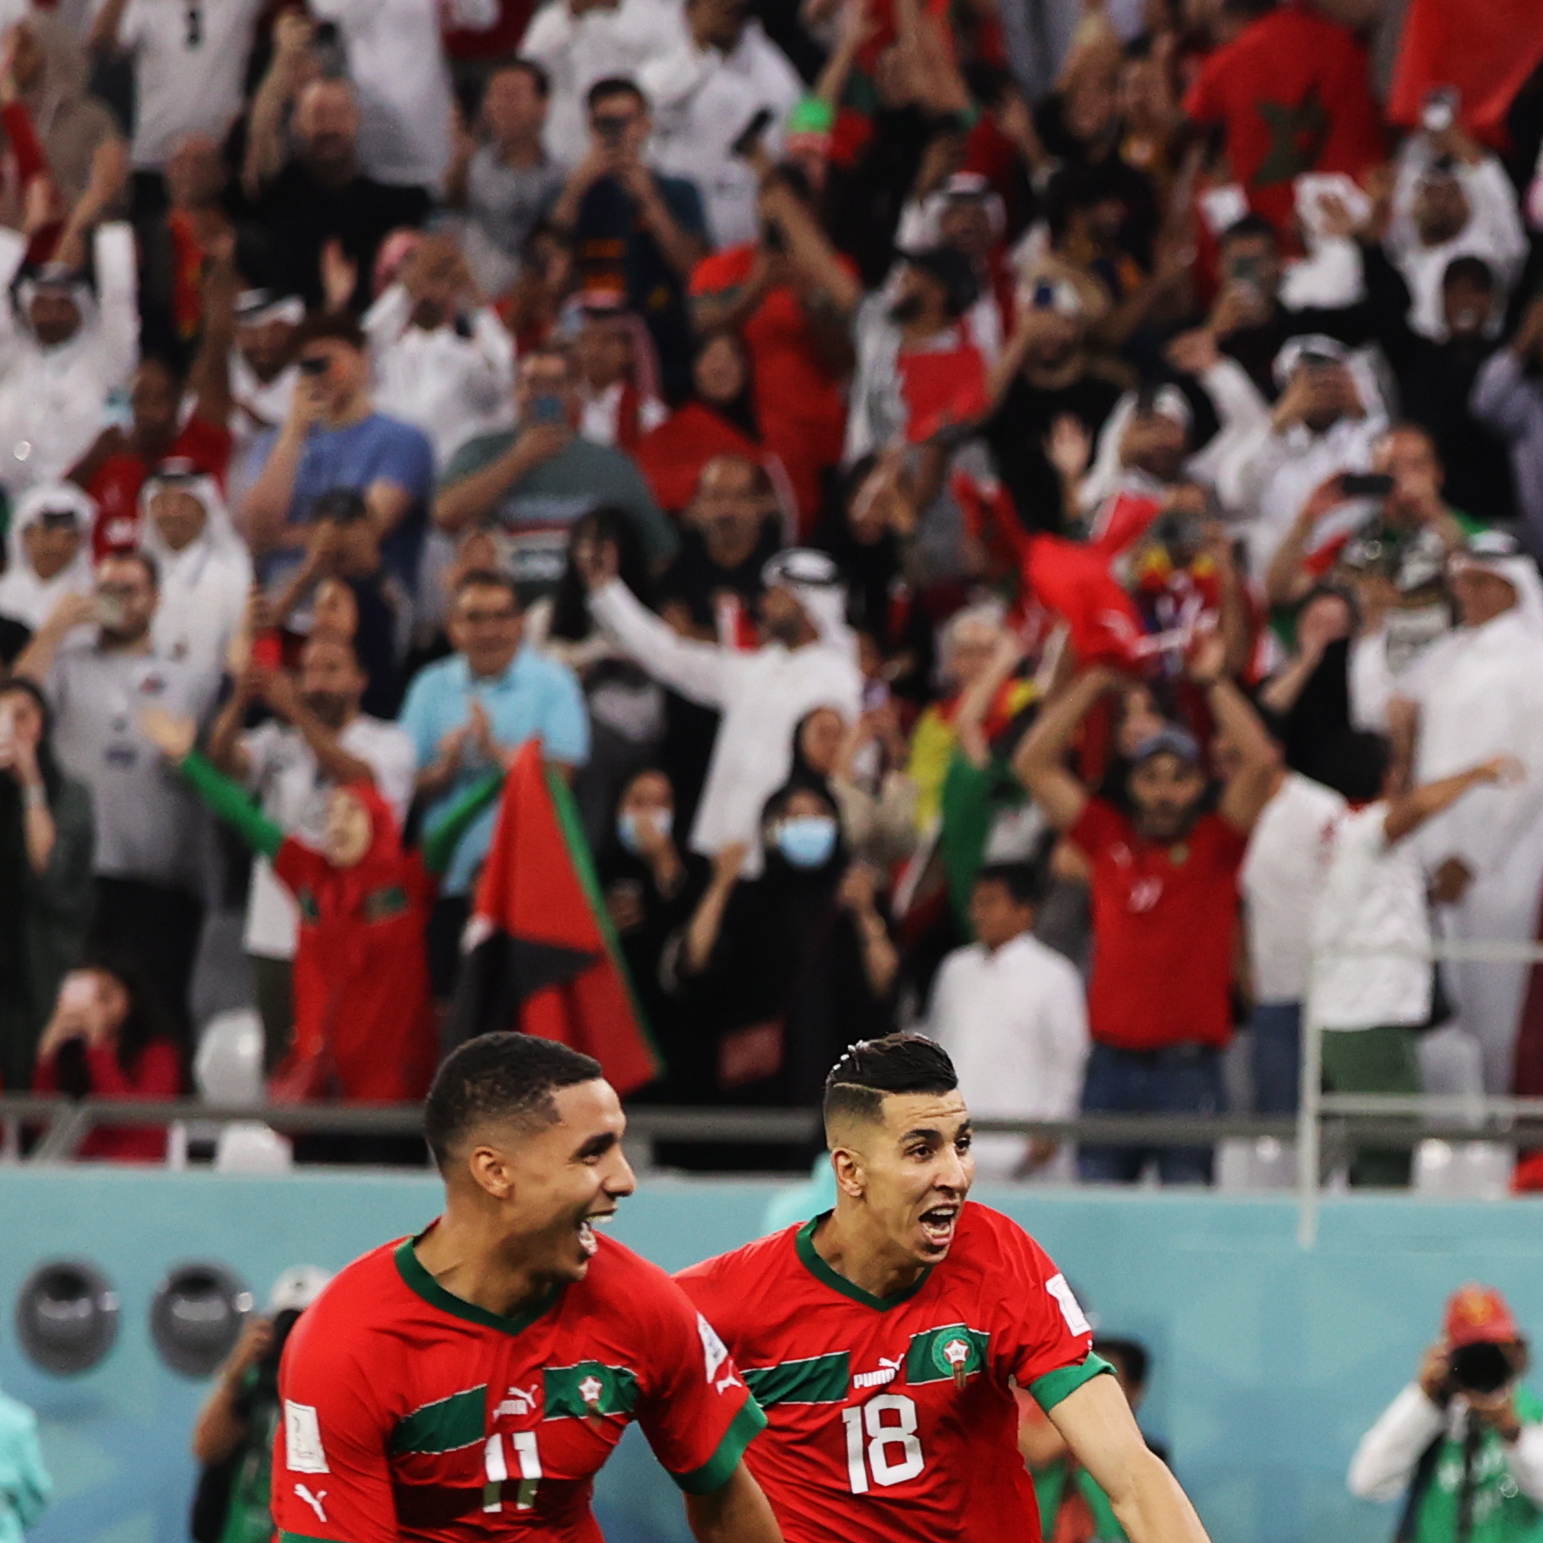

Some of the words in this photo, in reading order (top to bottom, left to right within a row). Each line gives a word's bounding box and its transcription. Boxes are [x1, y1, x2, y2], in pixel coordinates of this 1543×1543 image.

[853, 1368, 896, 1389] PUMA
[483, 1431, 543, 1513] 11
[842, 1394, 925, 1494] 18
